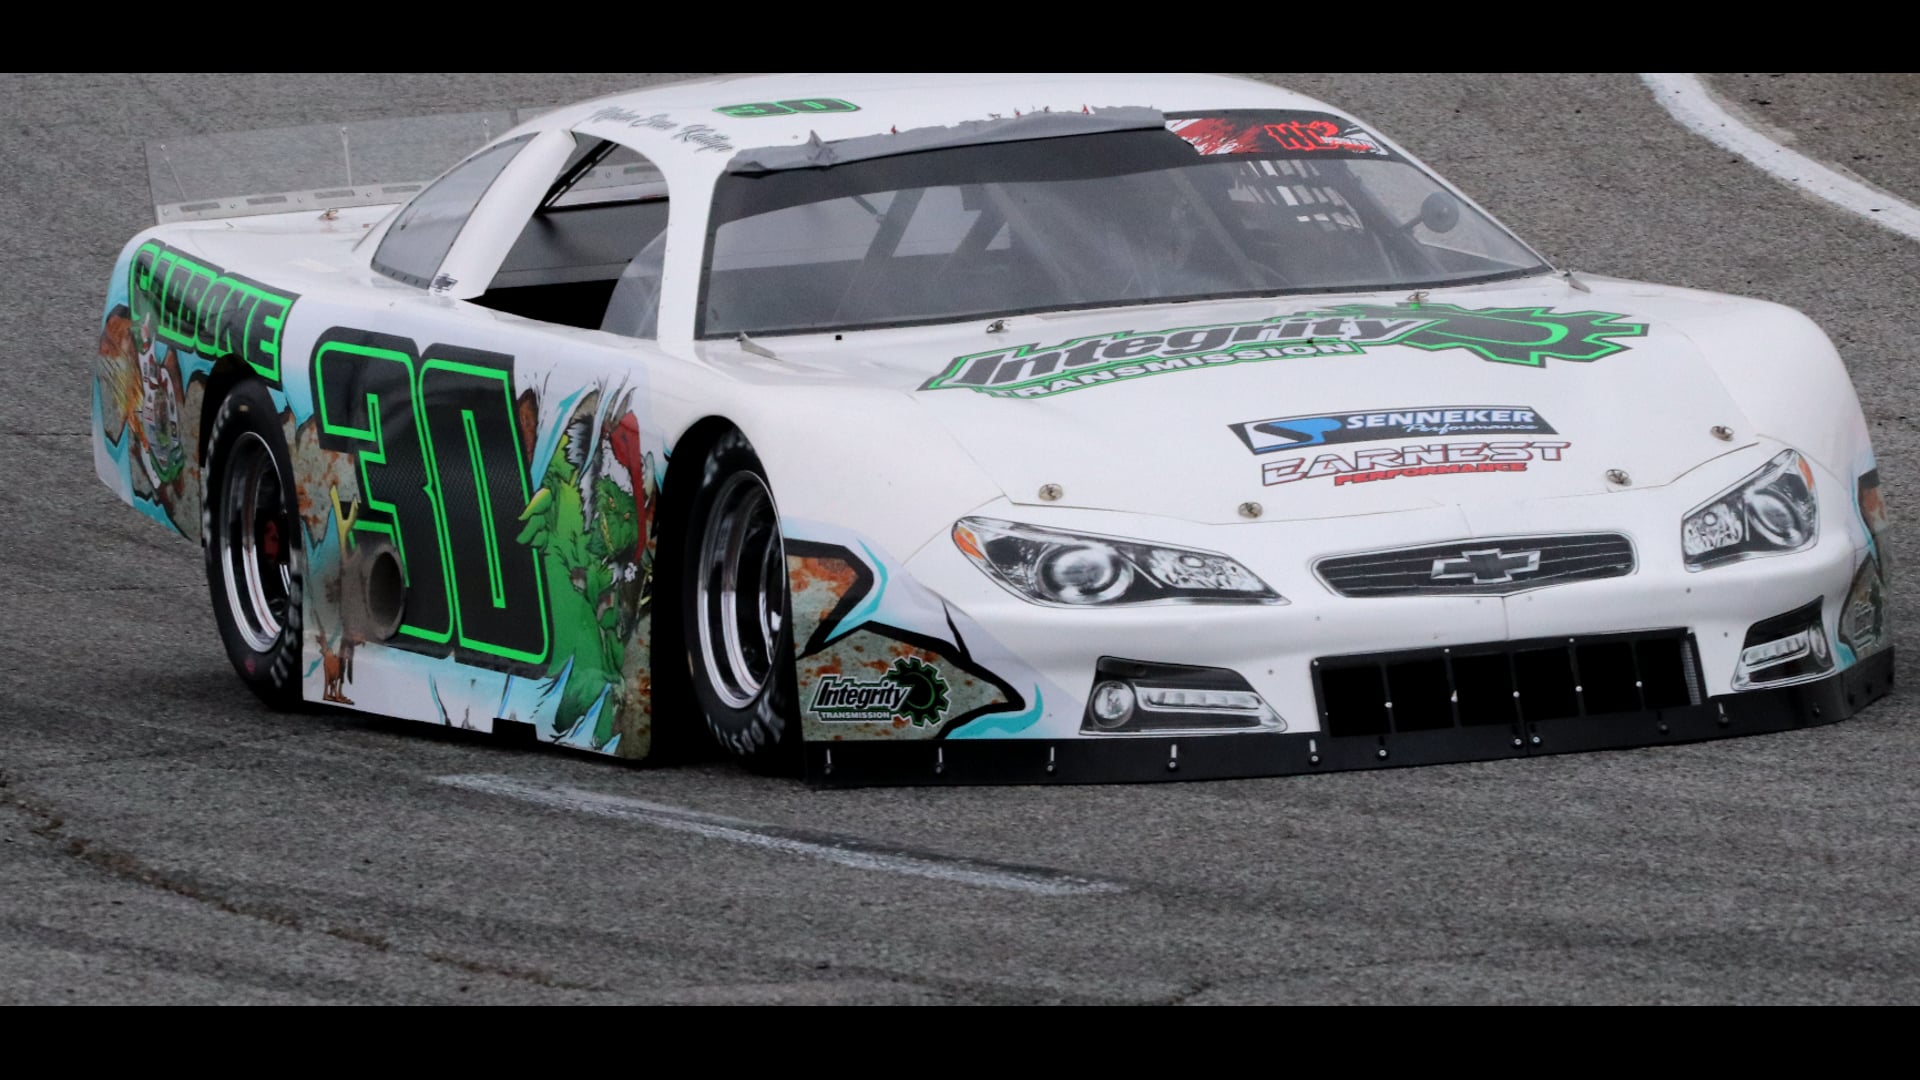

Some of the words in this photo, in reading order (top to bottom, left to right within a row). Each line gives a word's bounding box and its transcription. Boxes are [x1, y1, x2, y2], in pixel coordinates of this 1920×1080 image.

[951, 314, 1425, 385] Integrity
[1002, 343, 1360, 397] TRANSMISSION
[1346, 410, 1535, 429] SENNEKER
[1402, 423, 1538, 435] Performance
[1261, 441, 1571, 486] EARNEST
[1334, 463, 1528, 487] PERFORMANCE
[310, 327, 553, 680] 30
[816, 680, 910, 710] Integrity
[821, 711, 890, 719] TRANSMISSION
